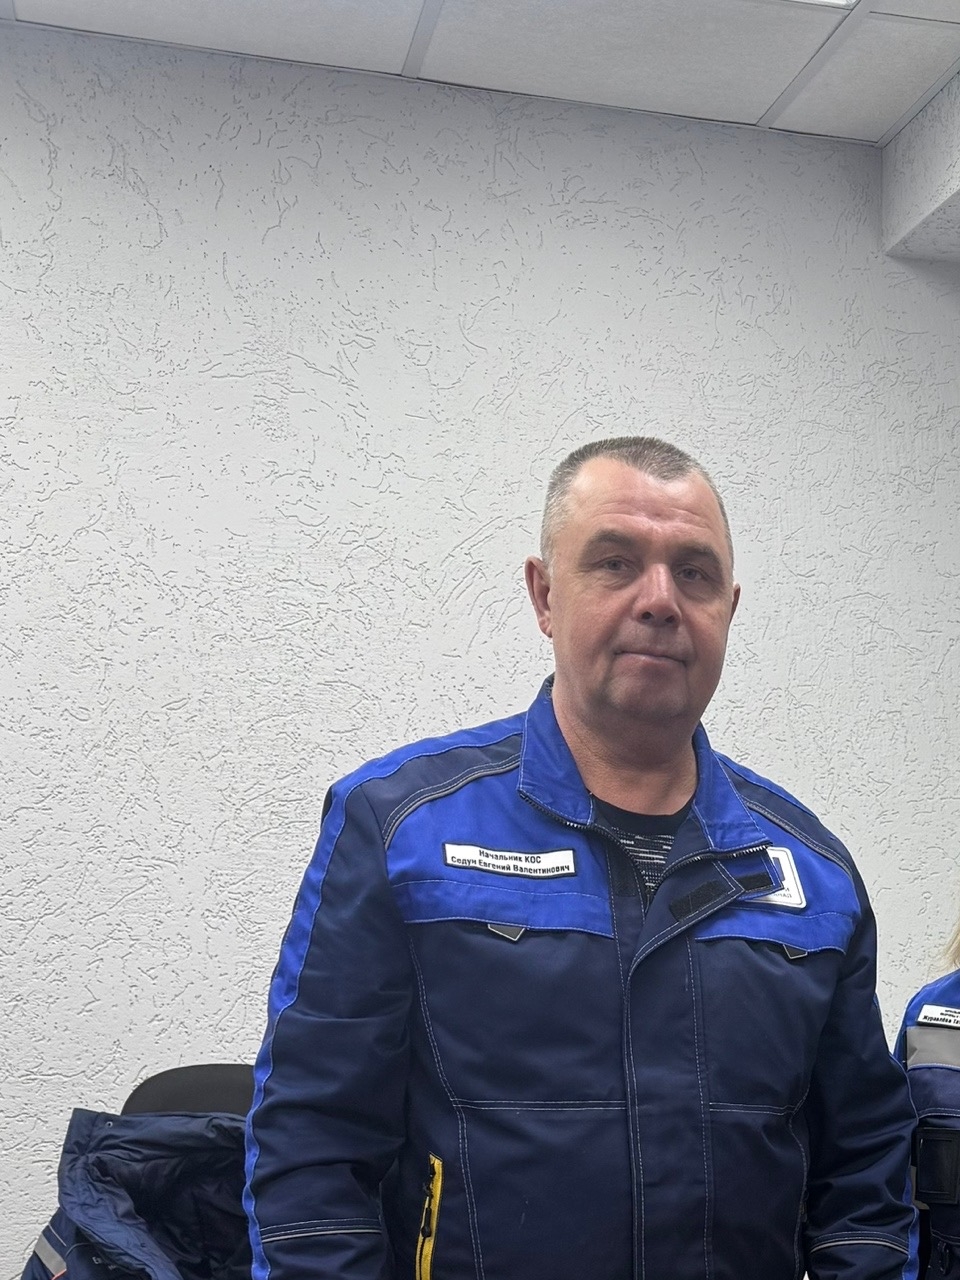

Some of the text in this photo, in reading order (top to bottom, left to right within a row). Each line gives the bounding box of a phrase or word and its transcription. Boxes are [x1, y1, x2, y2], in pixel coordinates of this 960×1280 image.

[479, 849, 541, 864] Начальник КОС
[478, 859, 511, 872] Евгений
[513, 864, 570, 875] Валентинович
